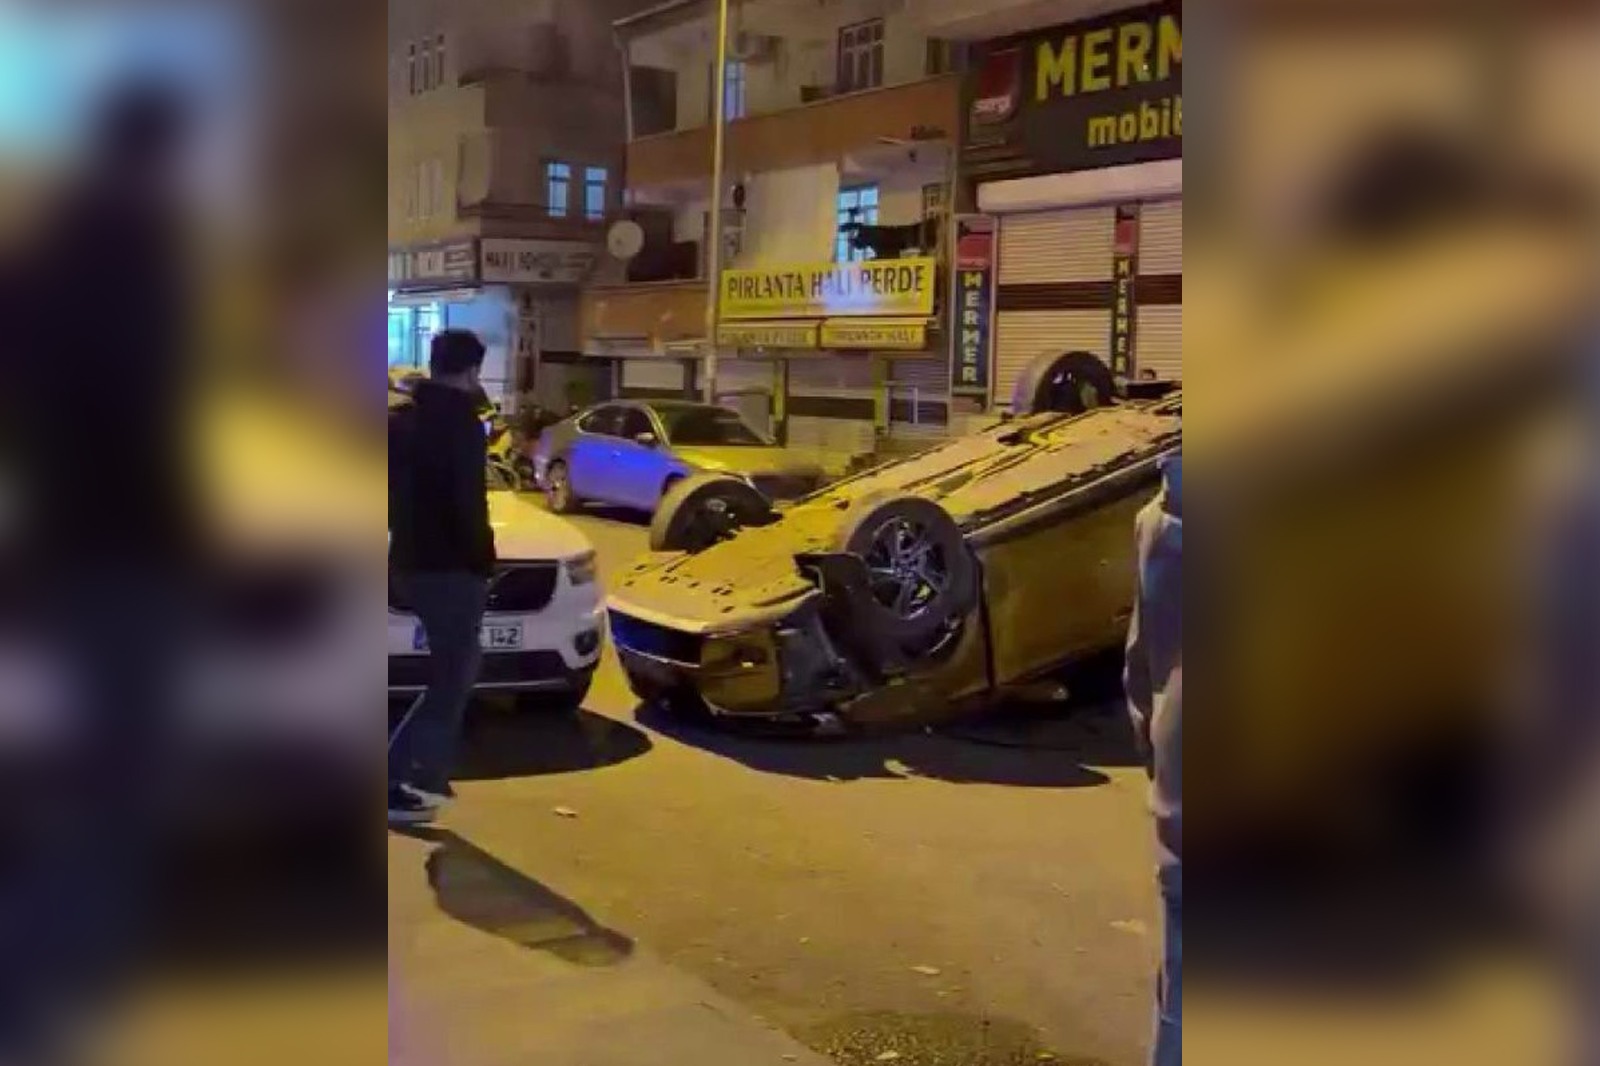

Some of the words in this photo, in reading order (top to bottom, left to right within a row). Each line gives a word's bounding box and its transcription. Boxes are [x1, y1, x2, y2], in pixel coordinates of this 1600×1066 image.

[727, 273, 806, 299] PIRLANTA
[811, 268, 852, 297] HALI
[859, 264, 926, 295] PERDE
[1116, 258, 1130, 373] MERMER
[962, 271, 983, 382] MERMER
[490, 627, 518, 647] 142
